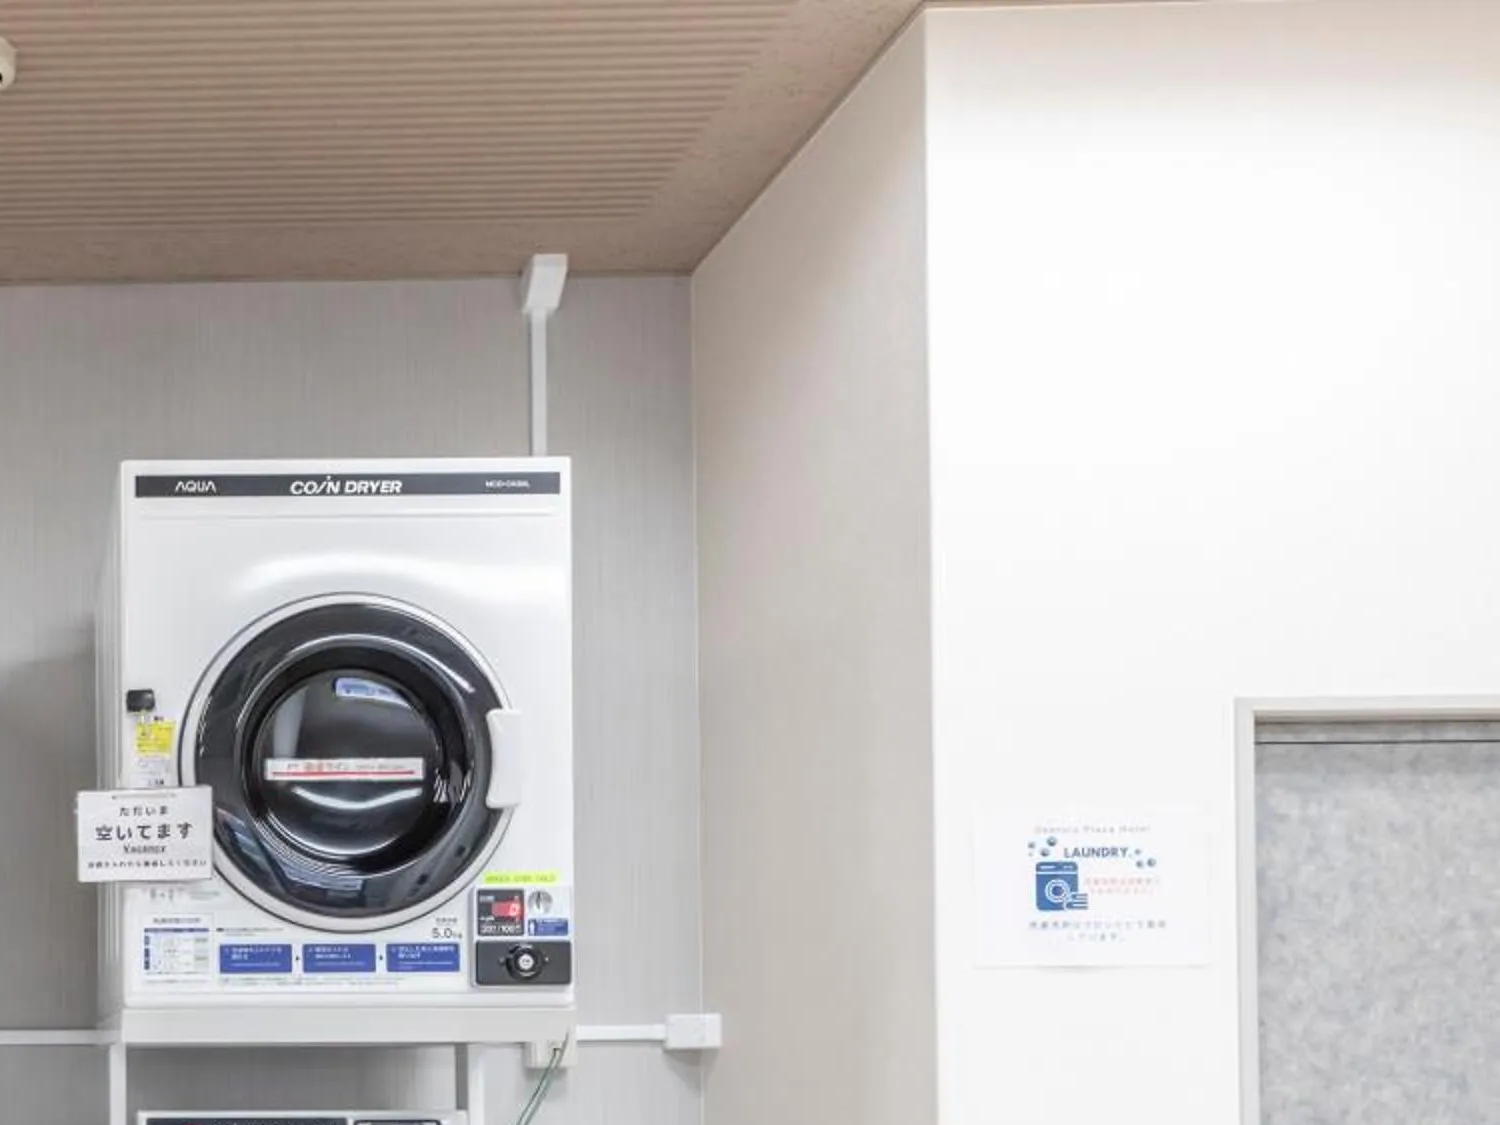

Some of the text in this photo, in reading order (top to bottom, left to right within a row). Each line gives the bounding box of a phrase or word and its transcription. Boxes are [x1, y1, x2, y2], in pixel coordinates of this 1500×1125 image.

[175, 481, 217, 494] AQUA
[344, 480, 403, 494] DRYER
[119, 805, 169, 817] ただいま
[95, 821, 193, 841] 空いてます
